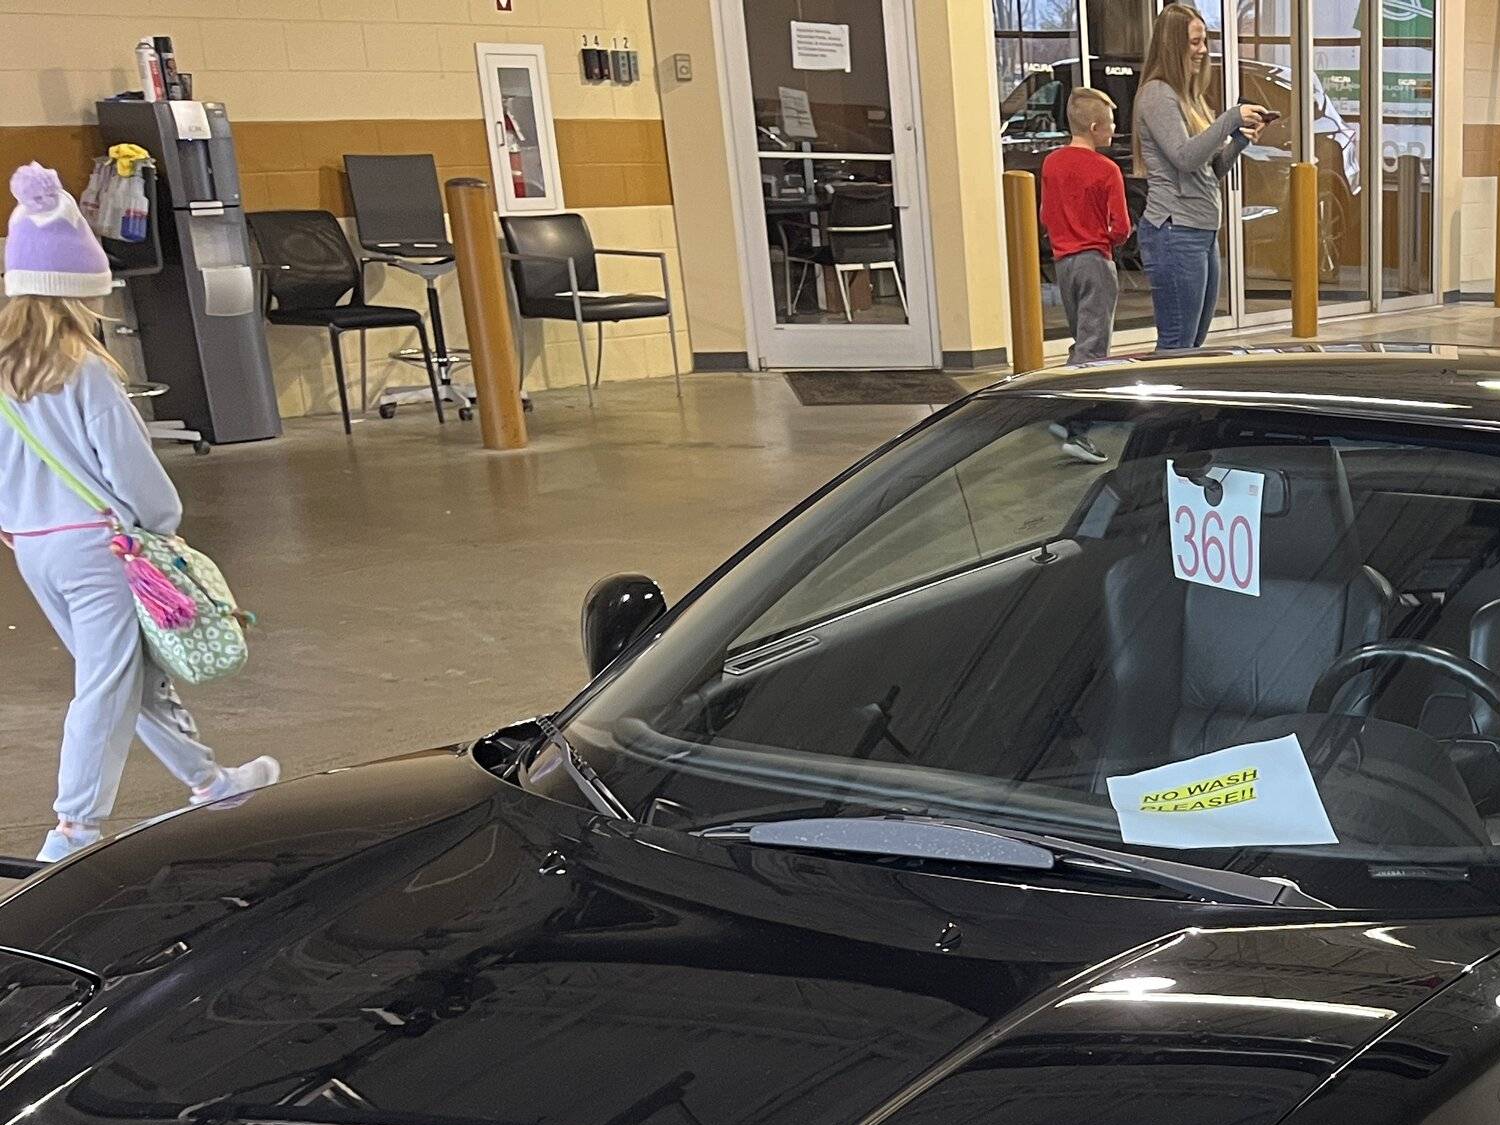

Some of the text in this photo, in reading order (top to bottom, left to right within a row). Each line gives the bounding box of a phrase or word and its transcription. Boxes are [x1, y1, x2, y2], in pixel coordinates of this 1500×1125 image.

[582, 34, 588, 47] 3
[594, 35, 599, 46] 4
[623, 37, 629, 49] 2
[1175, 505, 1254, 590] 360
[1143, 769, 1258, 803] NO WASH
